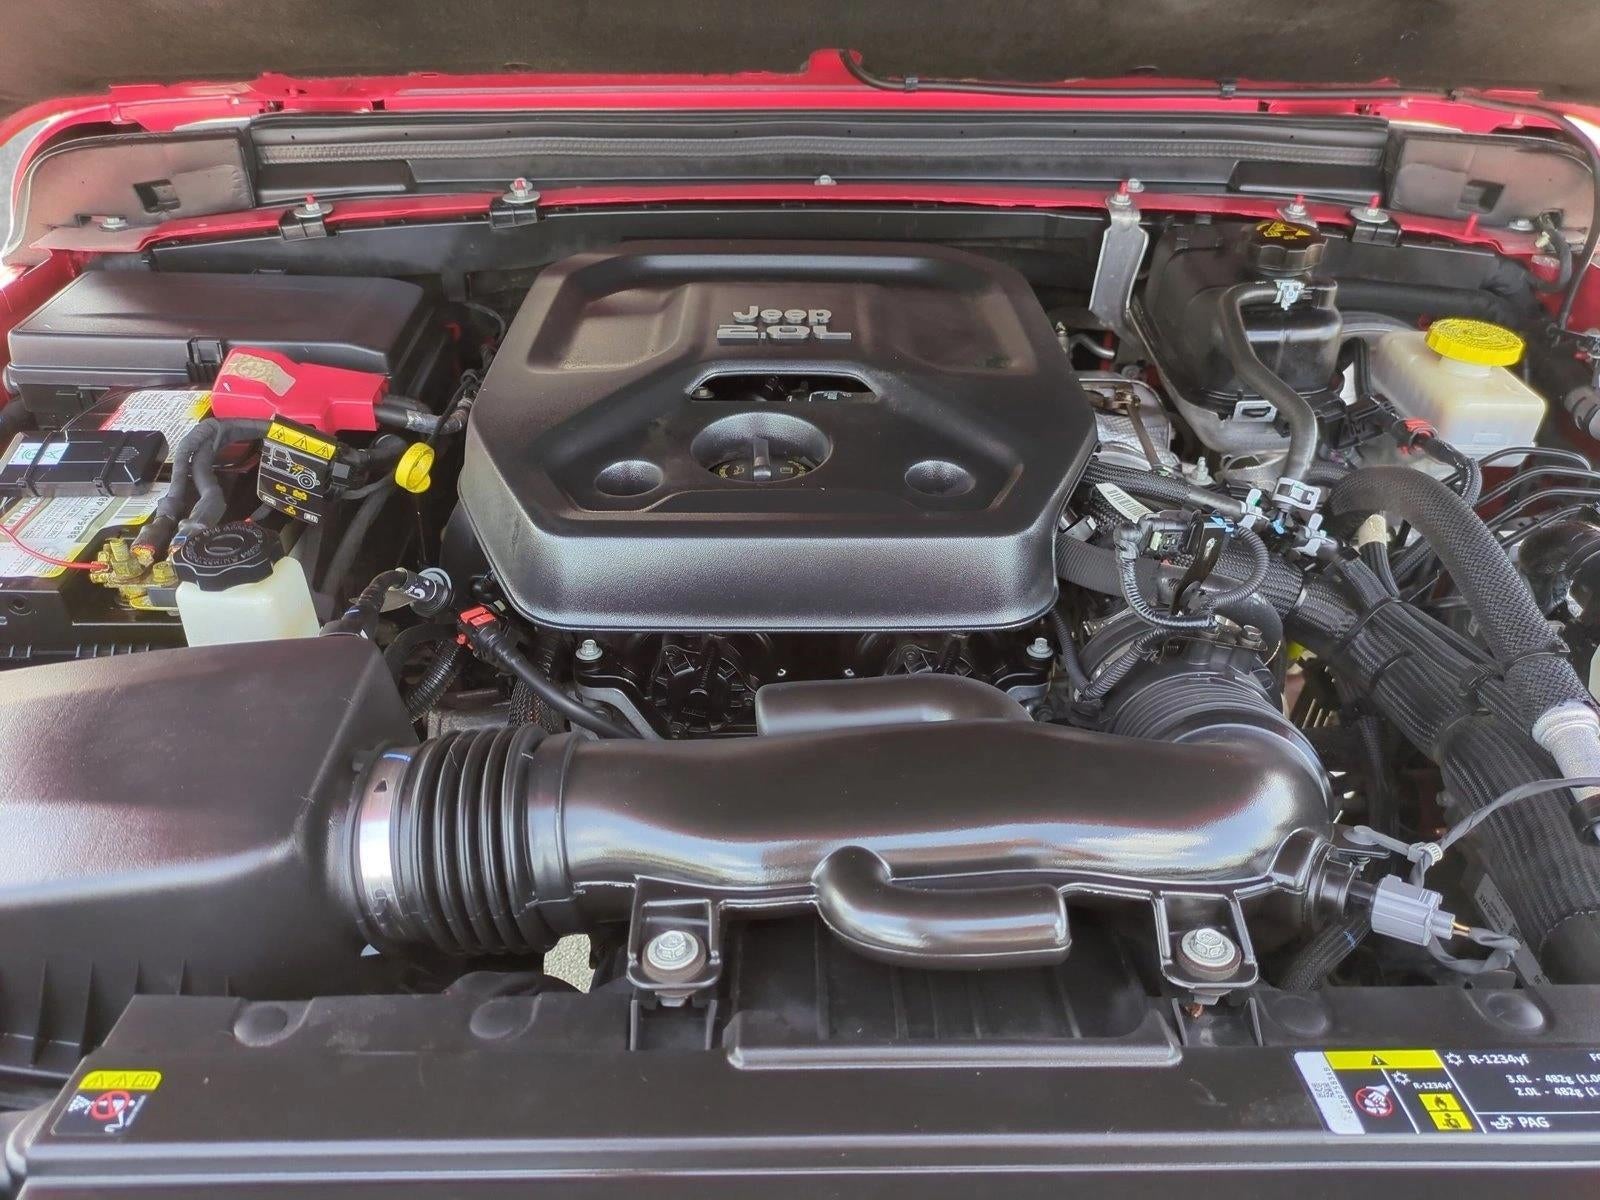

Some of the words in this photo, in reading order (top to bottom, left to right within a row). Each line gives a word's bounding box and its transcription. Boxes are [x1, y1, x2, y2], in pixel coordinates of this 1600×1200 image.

[732, 305, 832, 325] Jeep
[716, 324, 852, 343] 2.0L
[1468, 1053, 1530, 1066] R-1234yf
[1412, 1081, 1453, 1091] R-1234yf
[1505, 1074, 1533, 1084] 3.6L
[1544, 1074, 1575, 1085] 482g
[1514, 1086, 1542, 1097] 2.0L
[1554, 1086, 1585, 1098] 482g
[1517, 1115, 1551, 1129] PAG
